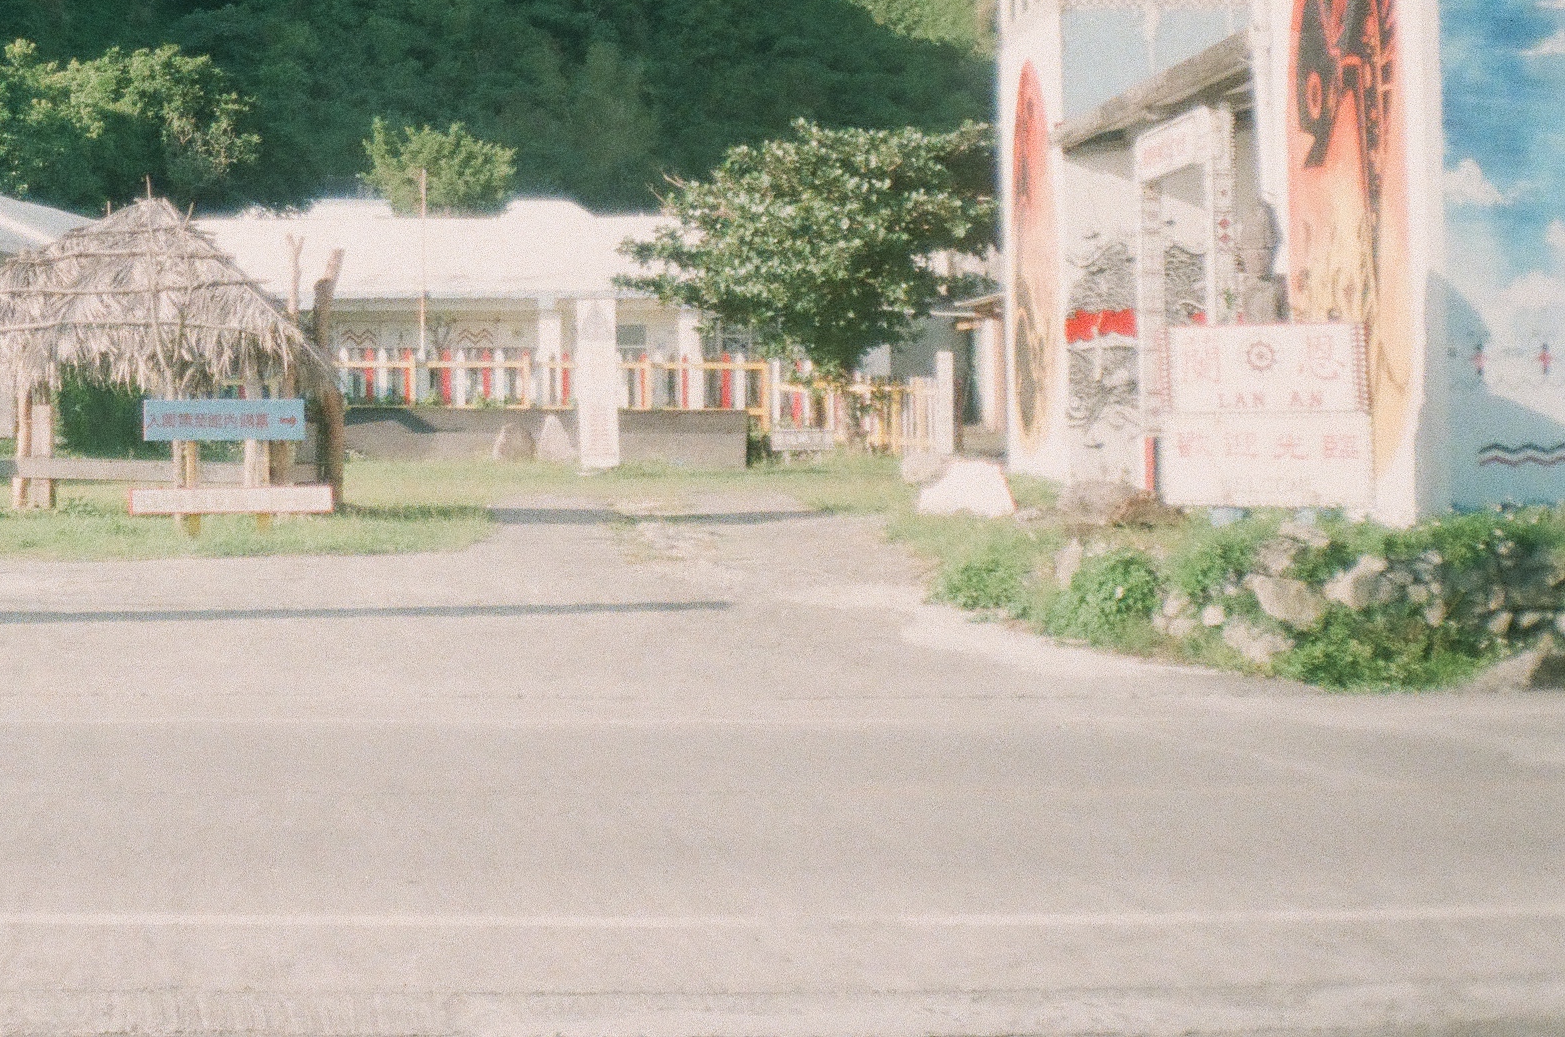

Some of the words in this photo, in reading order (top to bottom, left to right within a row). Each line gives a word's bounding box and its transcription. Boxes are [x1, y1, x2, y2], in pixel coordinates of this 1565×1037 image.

[1216, 392, 1266, 409] LAN
[1176, 431, 1361, 460] 歡迎光臨
